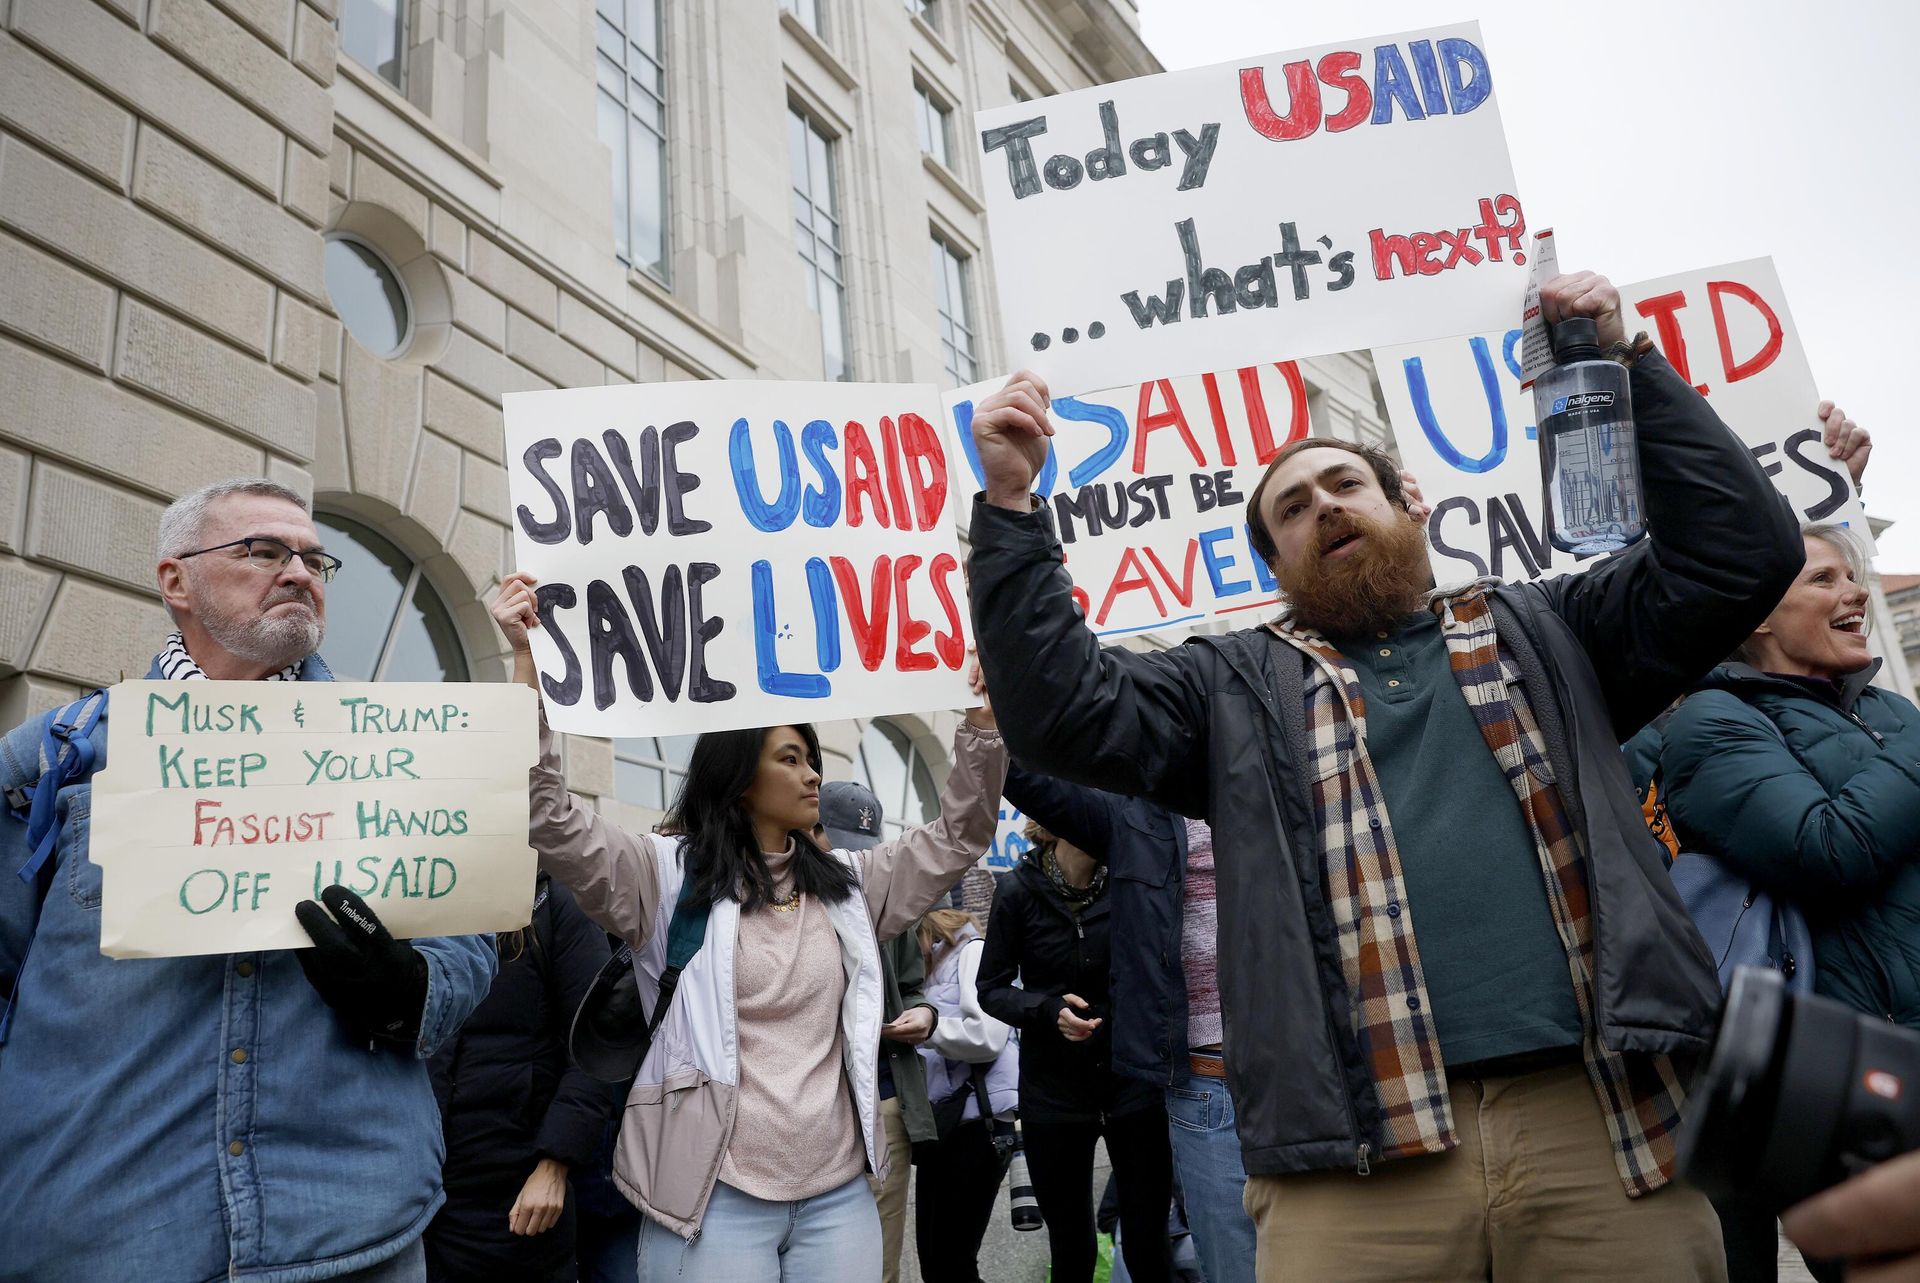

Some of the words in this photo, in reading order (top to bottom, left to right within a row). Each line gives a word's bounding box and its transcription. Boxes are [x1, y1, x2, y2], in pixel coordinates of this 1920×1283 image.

[982, 100, 1220, 199] Today
[1239, 38, 1492, 142] USAID
[1368, 194, 1526, 281] next?
[1403, 281, 1783, 474] UID
[1568, 394, 1610, 406] nalgene
[517, 421, 713, 545] SAVE
[728, 412, 948, 533] USAID
[1054, 474, 1173, 544] MUST
[1190, 470, 1244, 513] BE
[1063, 523, 1280, 627] AVE
[536, 562, 737, 711] SAVE
[751, 552, 966, 698] LIVES
[146, 691, 263, 737] MUSK
[340, 697, 469, 733] TRUMP:
[159, 744, 267, 788] KEEP
[303, 747, 420, 785] YOUR
[193, 800, 334, 847] FASCIST
[356, 800, 469, 839] HANDS
[179, 868, 271, 915] OFF
[313, 855, 457, 901] USAID
[339, 899, 377, 935] Timberland
